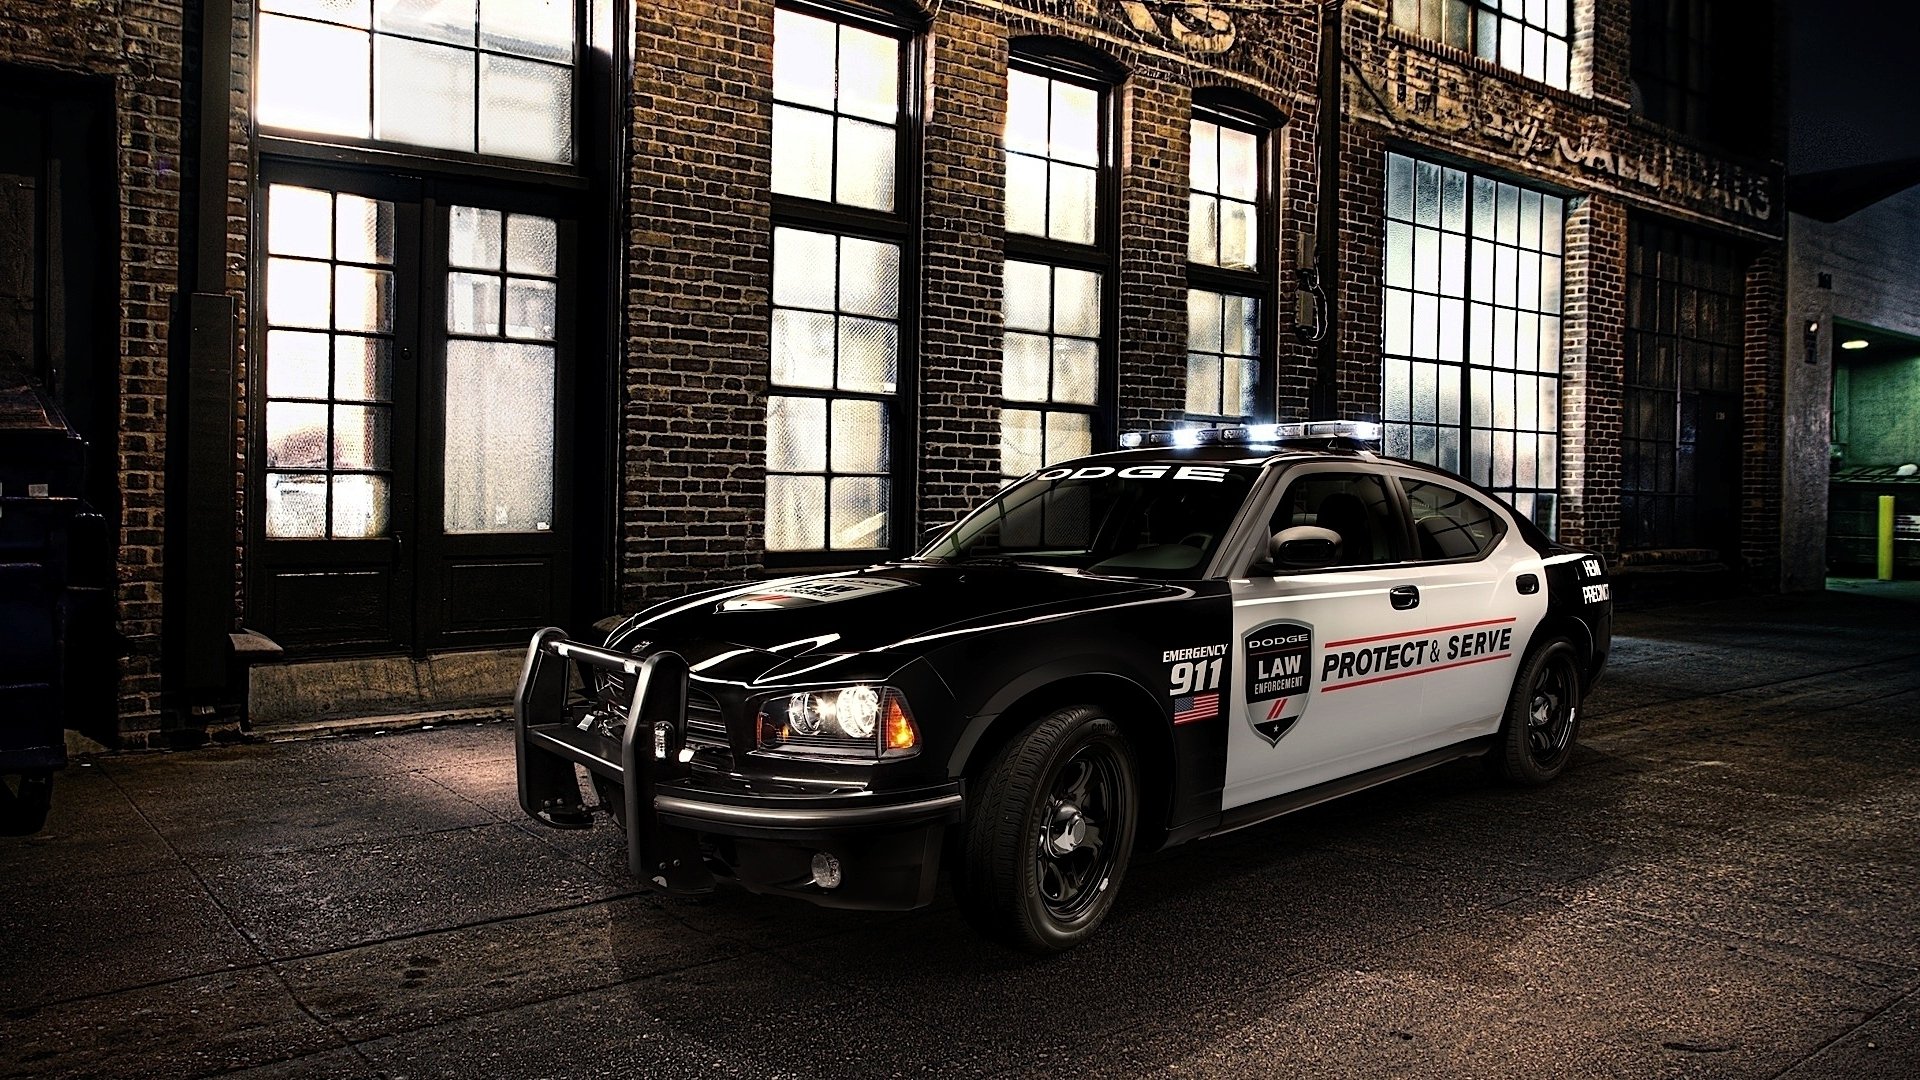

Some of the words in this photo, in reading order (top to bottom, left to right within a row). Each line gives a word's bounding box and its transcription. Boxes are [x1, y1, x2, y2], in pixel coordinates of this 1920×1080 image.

[1037, 465, 1231, 483] ODGE
[1249, 633, 1309, 649] DODGE
[1162, 643, 1229, 663] EMERGENCY
[1321, 639, 1429, 682] PROTECT
[1429, 640, 1440, 663] &
[1447, 627, 1512, 660] SERVE
[1169, 657, 1223, 696] 911
[1258, 654, 1302, 680] LAW
[1254, 676, 1304, 695] ENFORCEMENT
